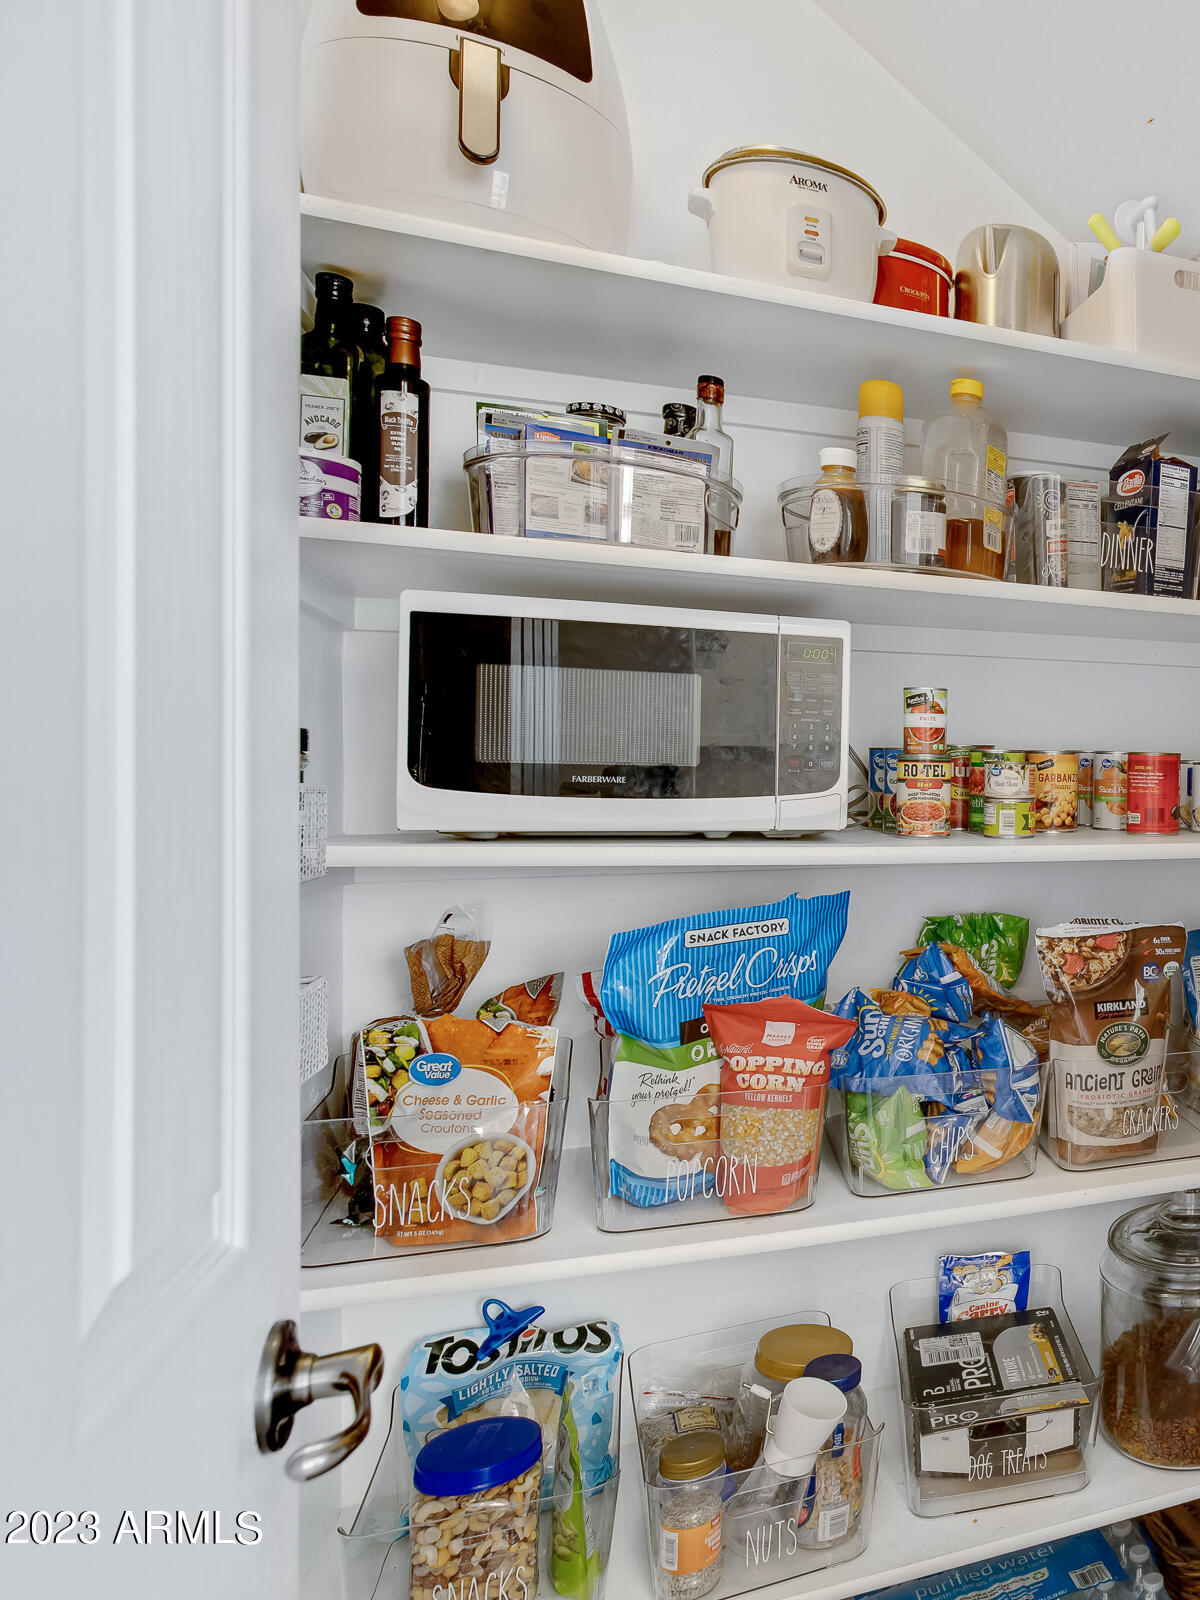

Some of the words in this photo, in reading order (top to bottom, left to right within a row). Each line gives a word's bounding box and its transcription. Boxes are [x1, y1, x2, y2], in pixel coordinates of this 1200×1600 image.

[789, 174, 829, 193] AROMA
[303, 414, 342, 429] AVOCADO
[647, 445, 684, 456] KIKKOMAN
[1121, 473, 1143, 491] Barilla
[1100, 531, 1154, 574] DINNER
[571, 775, 627, 784] FARBERWARE
[970, 797, 984, 808] etit
[688, 929, 730, 944] SNACK
[732, 921, 786, 938] FACTORY
[647, 952, 746, 1008] Pretzel
[745, 946, 817, 989] Crisps
[726, 993, 750, 1001] CRUNCHY
[750, 989, 768, 997] PRETZEL
[1096, 999, 1147, 1013] KIRKLAND
[1100, 1024, 1128, 1043] NATURE'S
[1129, 1025, 1146, 1040] PATH
[416, 1060, 455, 1072] Great
[1110, 1053, 1138, 1064] ORGANIC
[424, 1070, 452, 1079] Value
[638, 1072, 681, 1088] Rethink
[735, 1073, 806, 1093] CORN
[402, 1094, 450, 1106] Cheese
[453, 1094, 462, 1106] &
[466, 1094, 507, 1106] Garlic
[630, 1090, 653, 1107] your
[744, 1091, 768, 1103] YELLOW
[767, 1092, 793, 1103] KERNELS
[1080, 1092, 1126, 1100] PROBIOTIC
[418, 1108, 483, 1121] Seasoned
[1122, 1104, 1179, 1137] CRACKERS
[420, 1123, 478, 1134] Croutons
[930, 1125, 975, 1165] CHIPS
[664, 1152, 758, 1203] POPCORN
[372, 1176, 471, 1229] SNACKS
[968, 1300, 1000, 1312] Canine
[1002, 1356, 1016, 1384] MATURE
[458, 1366, 511, 1401] LIGHTLY
[515, 1363, 561, 1378] SALTED
[929, 1410, 979, 1428] PRO
[967, 1452, 994, 1482] DOG
[1000, 1446, 1048, 1477] TREATS
[745, 1517, 798, 1568] NUTS
[912, 1563, 994, 1600] purified
[997, 1544, 1057, 1571] water
[988, 1568, 1013, 1581] added
[1013, 1564, 1025, 1574] for
[1025, 1557, 1049, 1570] taste
